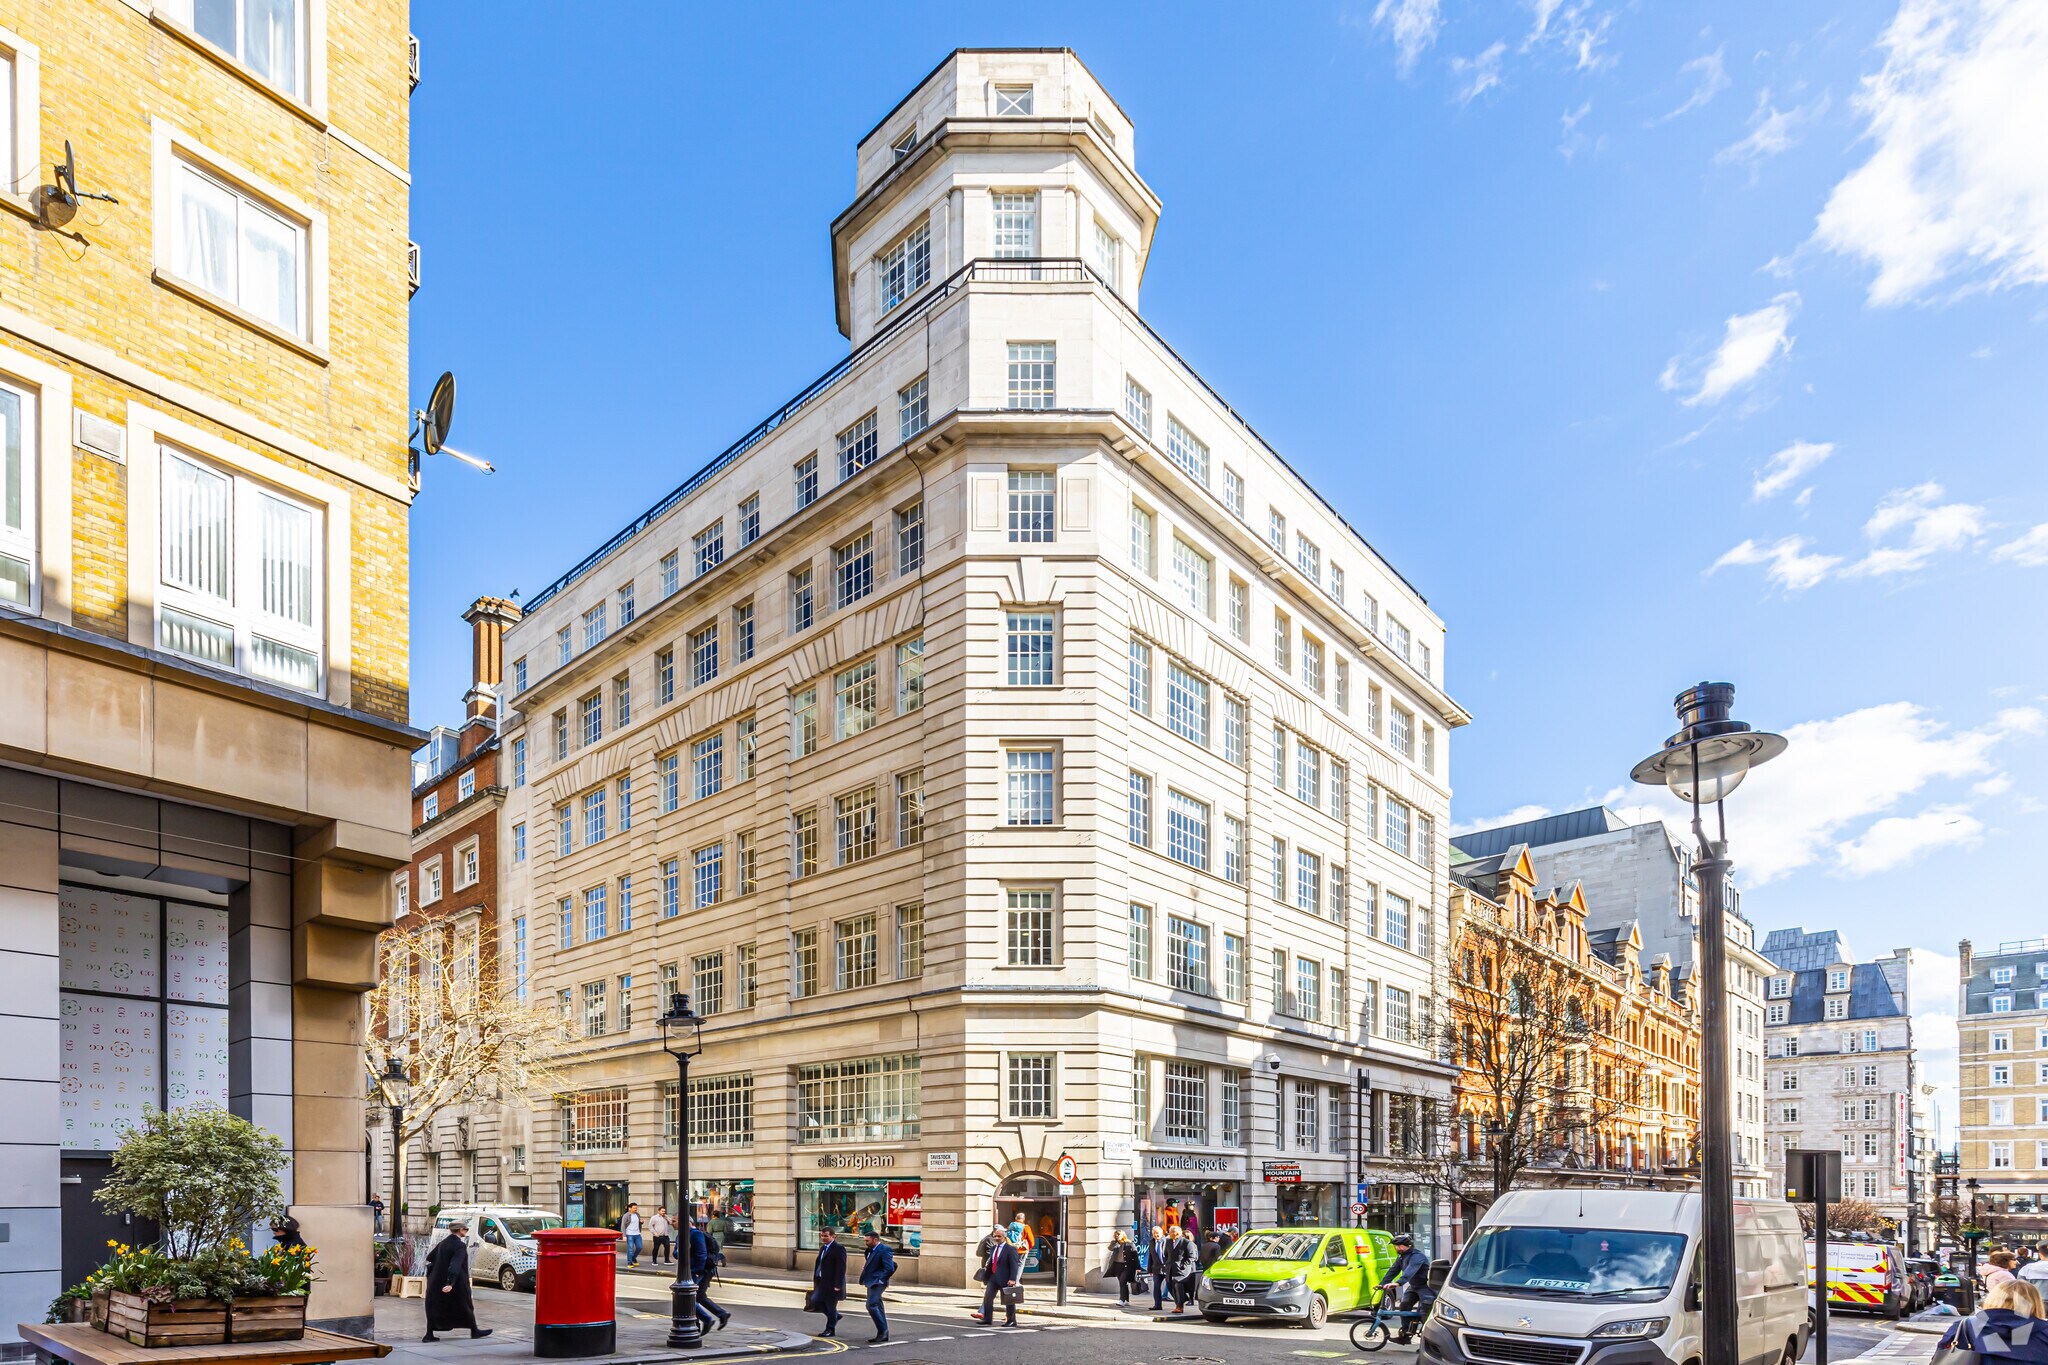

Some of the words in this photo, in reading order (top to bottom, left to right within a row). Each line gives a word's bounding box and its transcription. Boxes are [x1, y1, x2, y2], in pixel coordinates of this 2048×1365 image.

[817, 1153, 894, 1170] ellisbrigham
[1151, 1155, 1228, 1173] mountainsports
[889, 1197, 921, 1210] SALE
[1530, 1279, 1560, 1287] BF67
